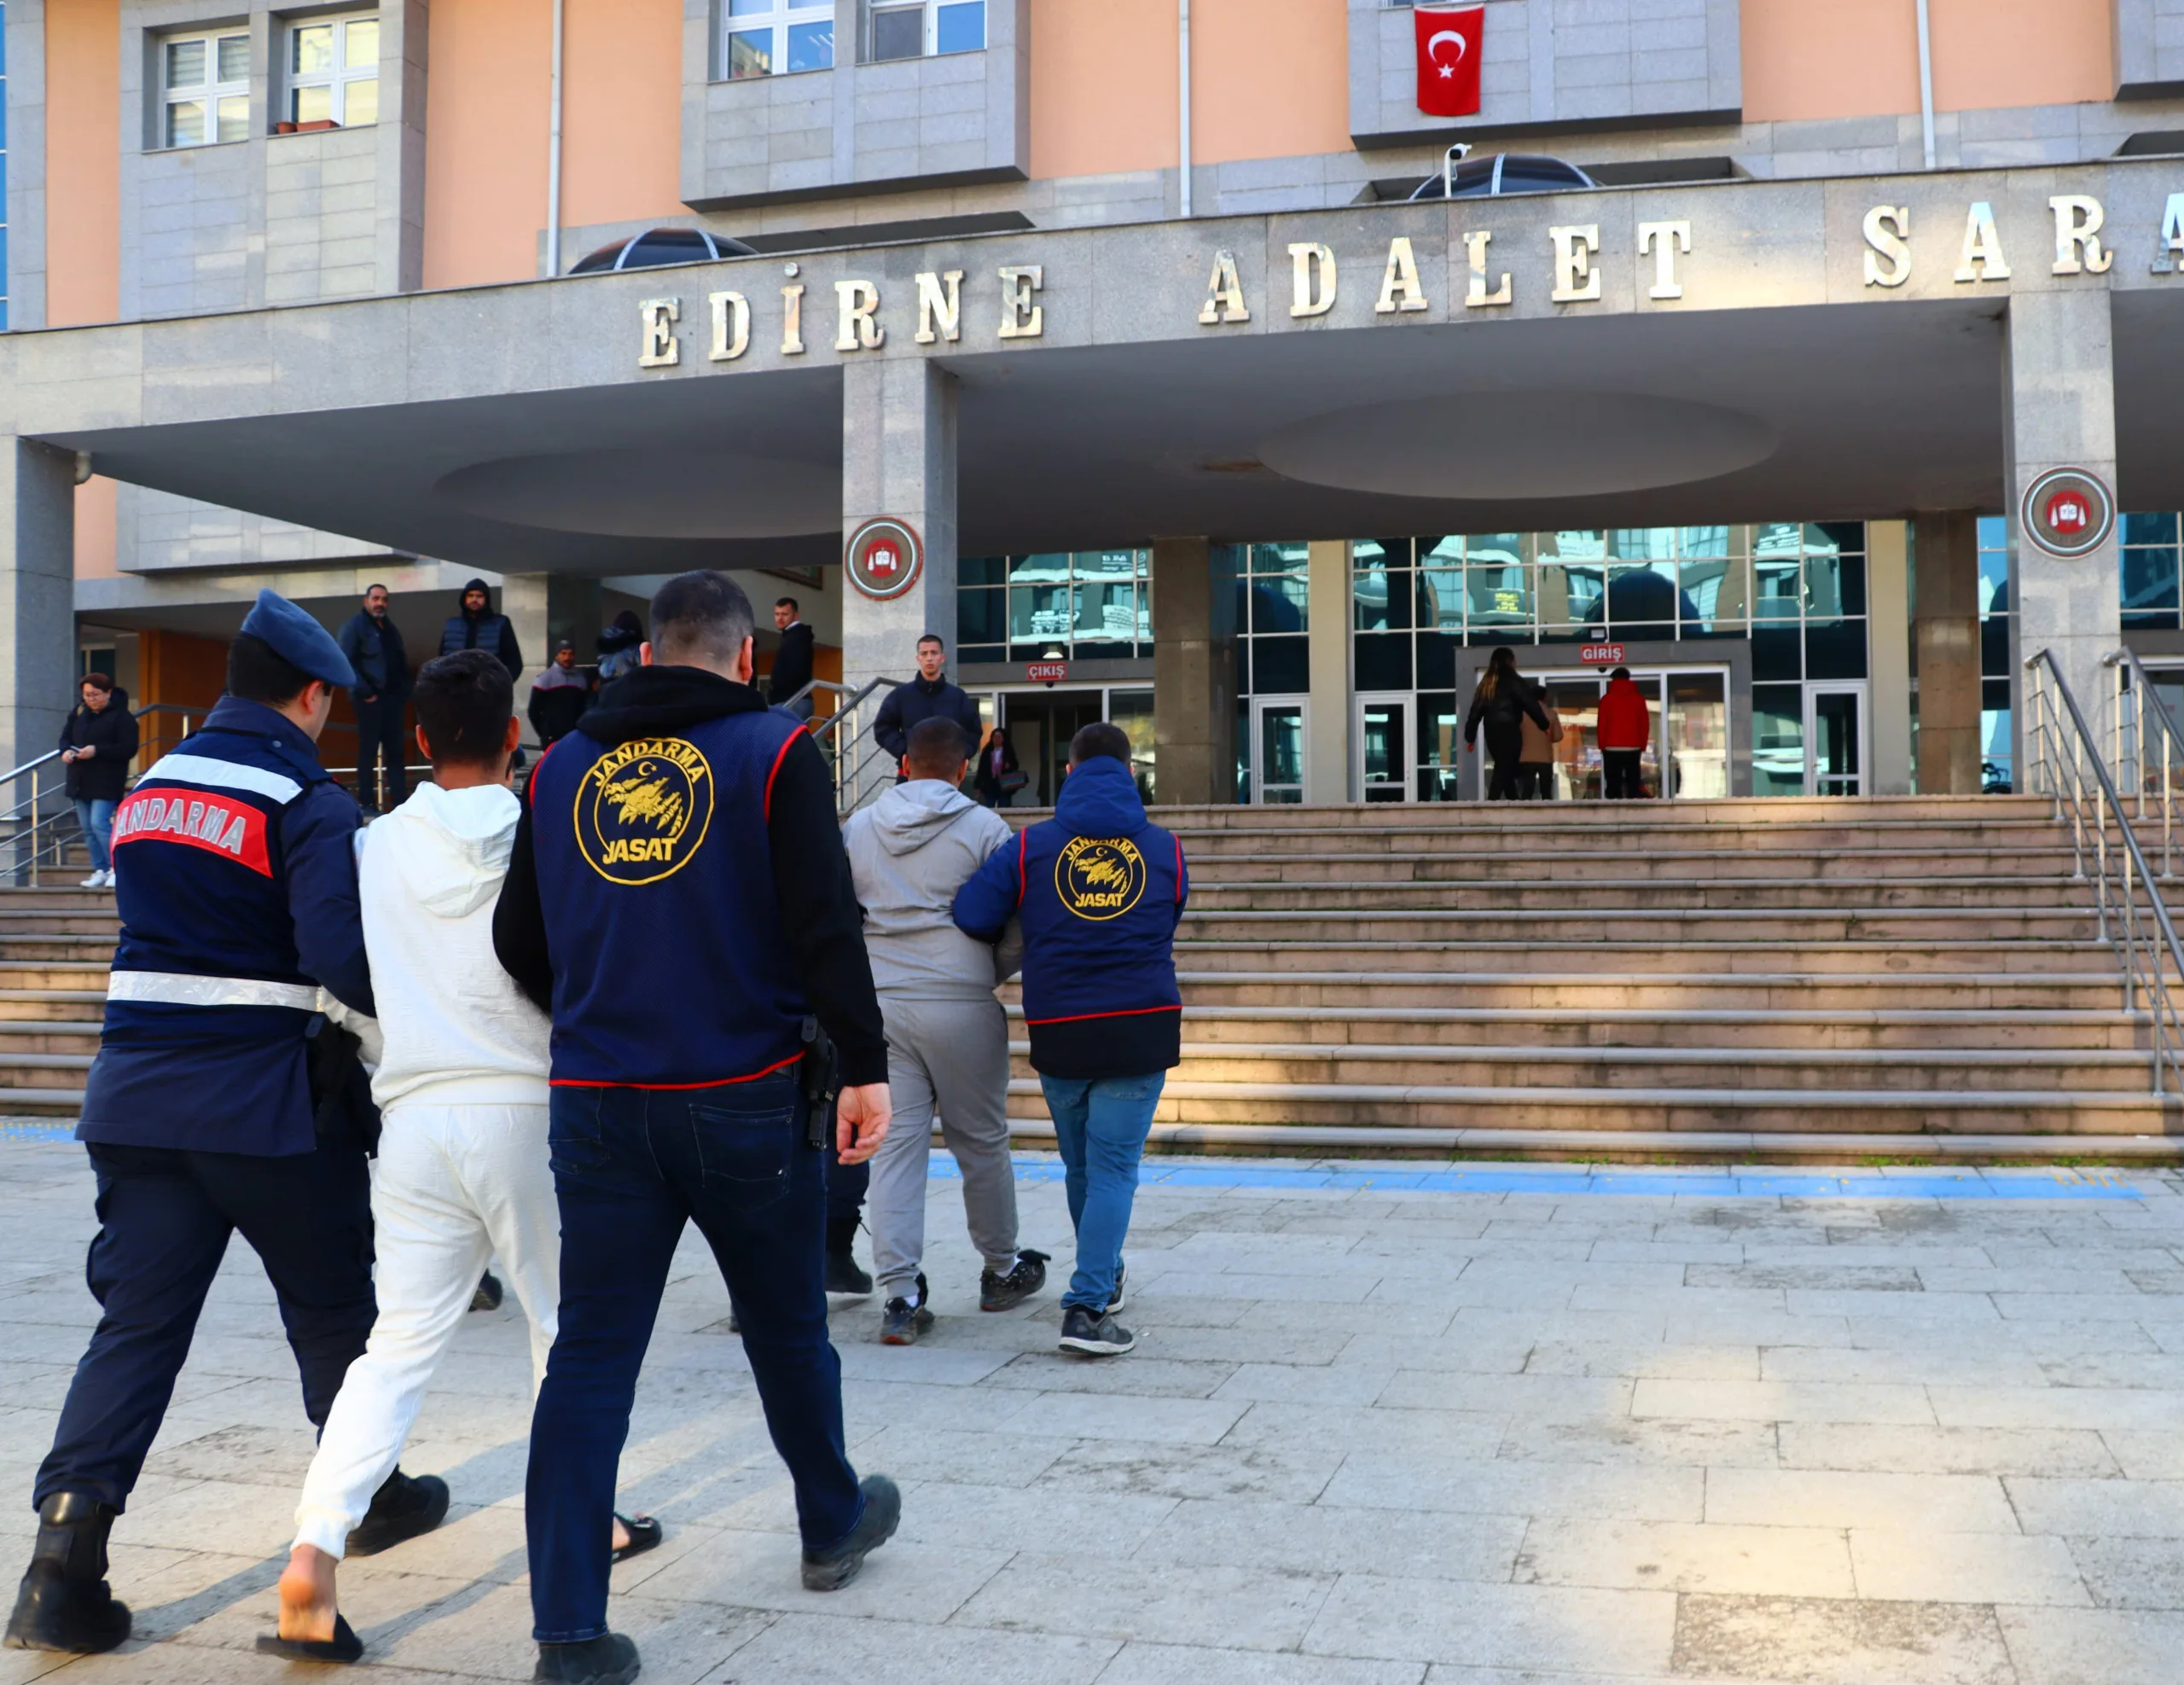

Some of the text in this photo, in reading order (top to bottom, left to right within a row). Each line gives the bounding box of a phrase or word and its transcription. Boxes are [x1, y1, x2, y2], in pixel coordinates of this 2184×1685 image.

[638, 262, 1043, 367] EDİRNE
[1199, 220, 1691, 324] ADALET
[1583, 645, 1622, 662] GİRİŞ
[1029, 665, 1065, 680] ÇIKIŞ
[592, 741, 706, 787] JANDARMA
[113, 798, 247, 855] ANDARMA
[602, 838, 677, 864] JASAT
[1075, 893, 1124, 907] JASAT
